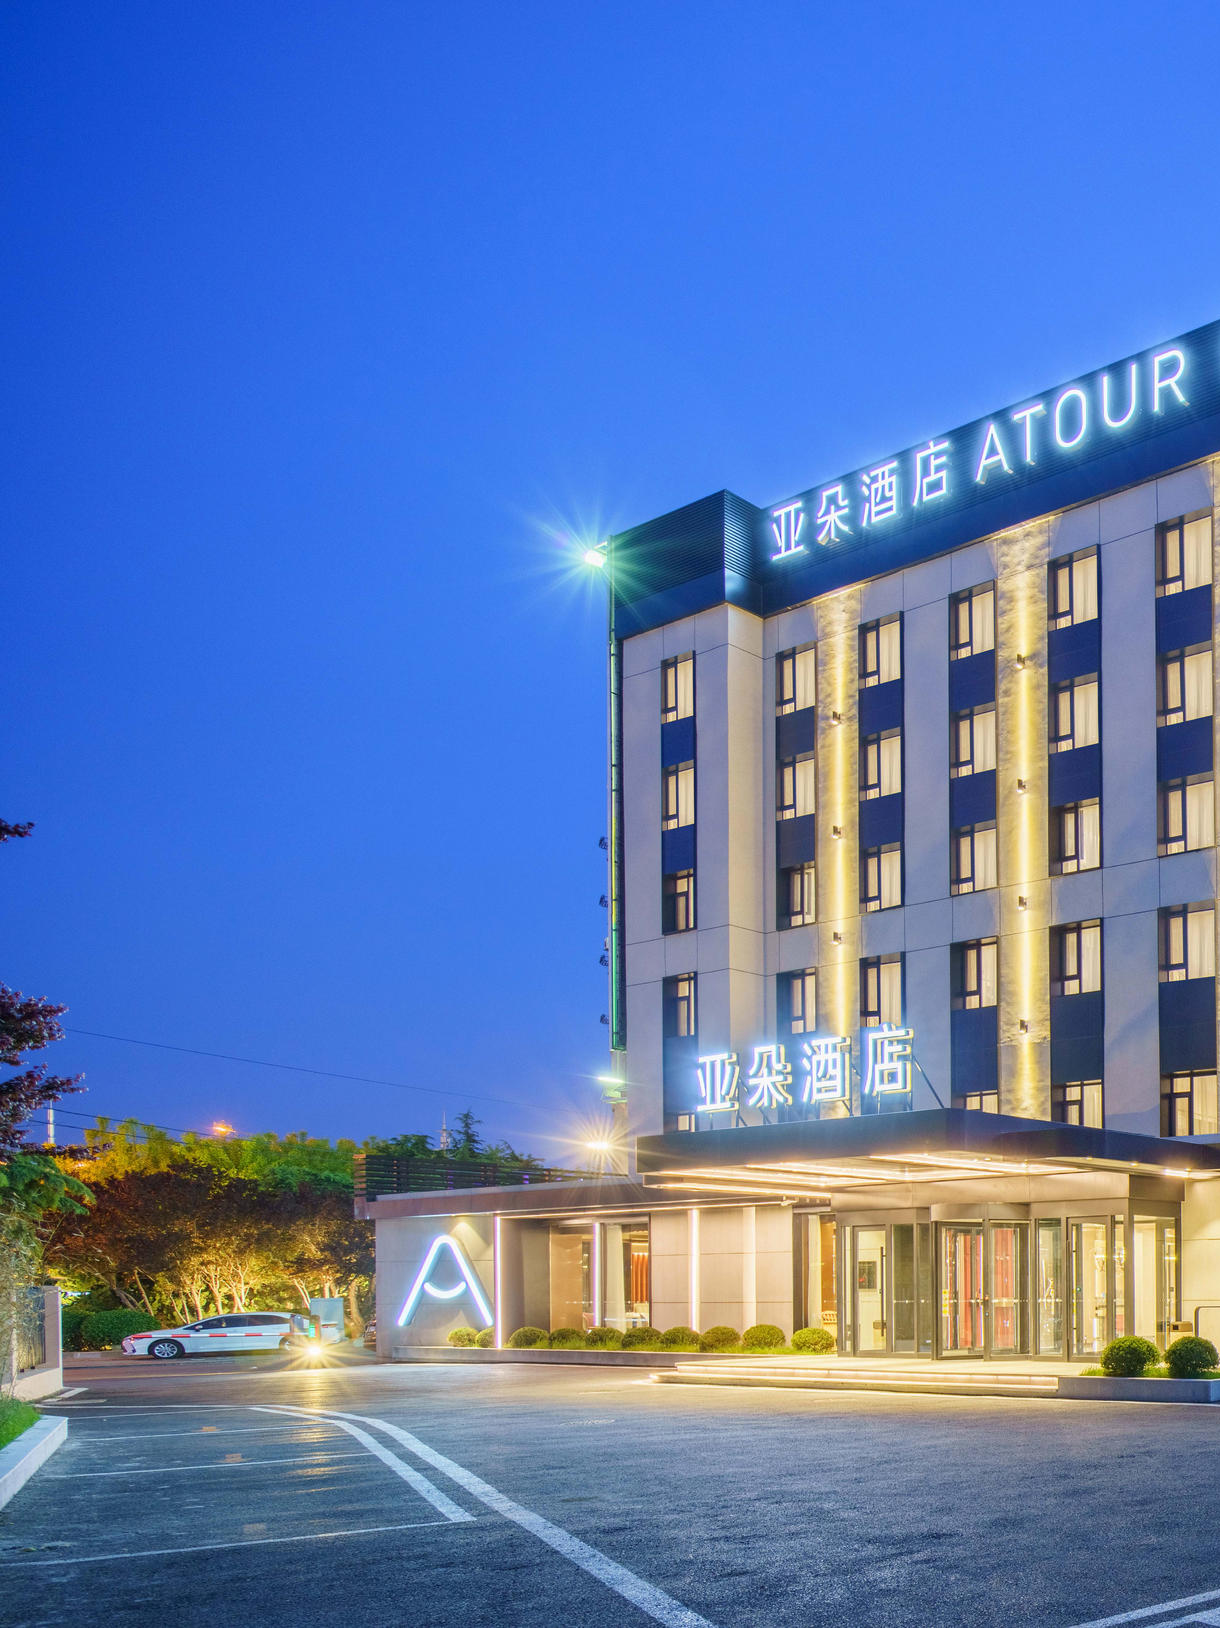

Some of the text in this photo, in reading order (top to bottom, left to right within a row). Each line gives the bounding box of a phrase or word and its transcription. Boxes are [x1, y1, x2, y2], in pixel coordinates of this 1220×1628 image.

[975, 348, 1187, 483] ATOUR
[770, 440, 950, 561] 亚朵酒店
[696, 1023, 914, 1112] 亚朵酒店
